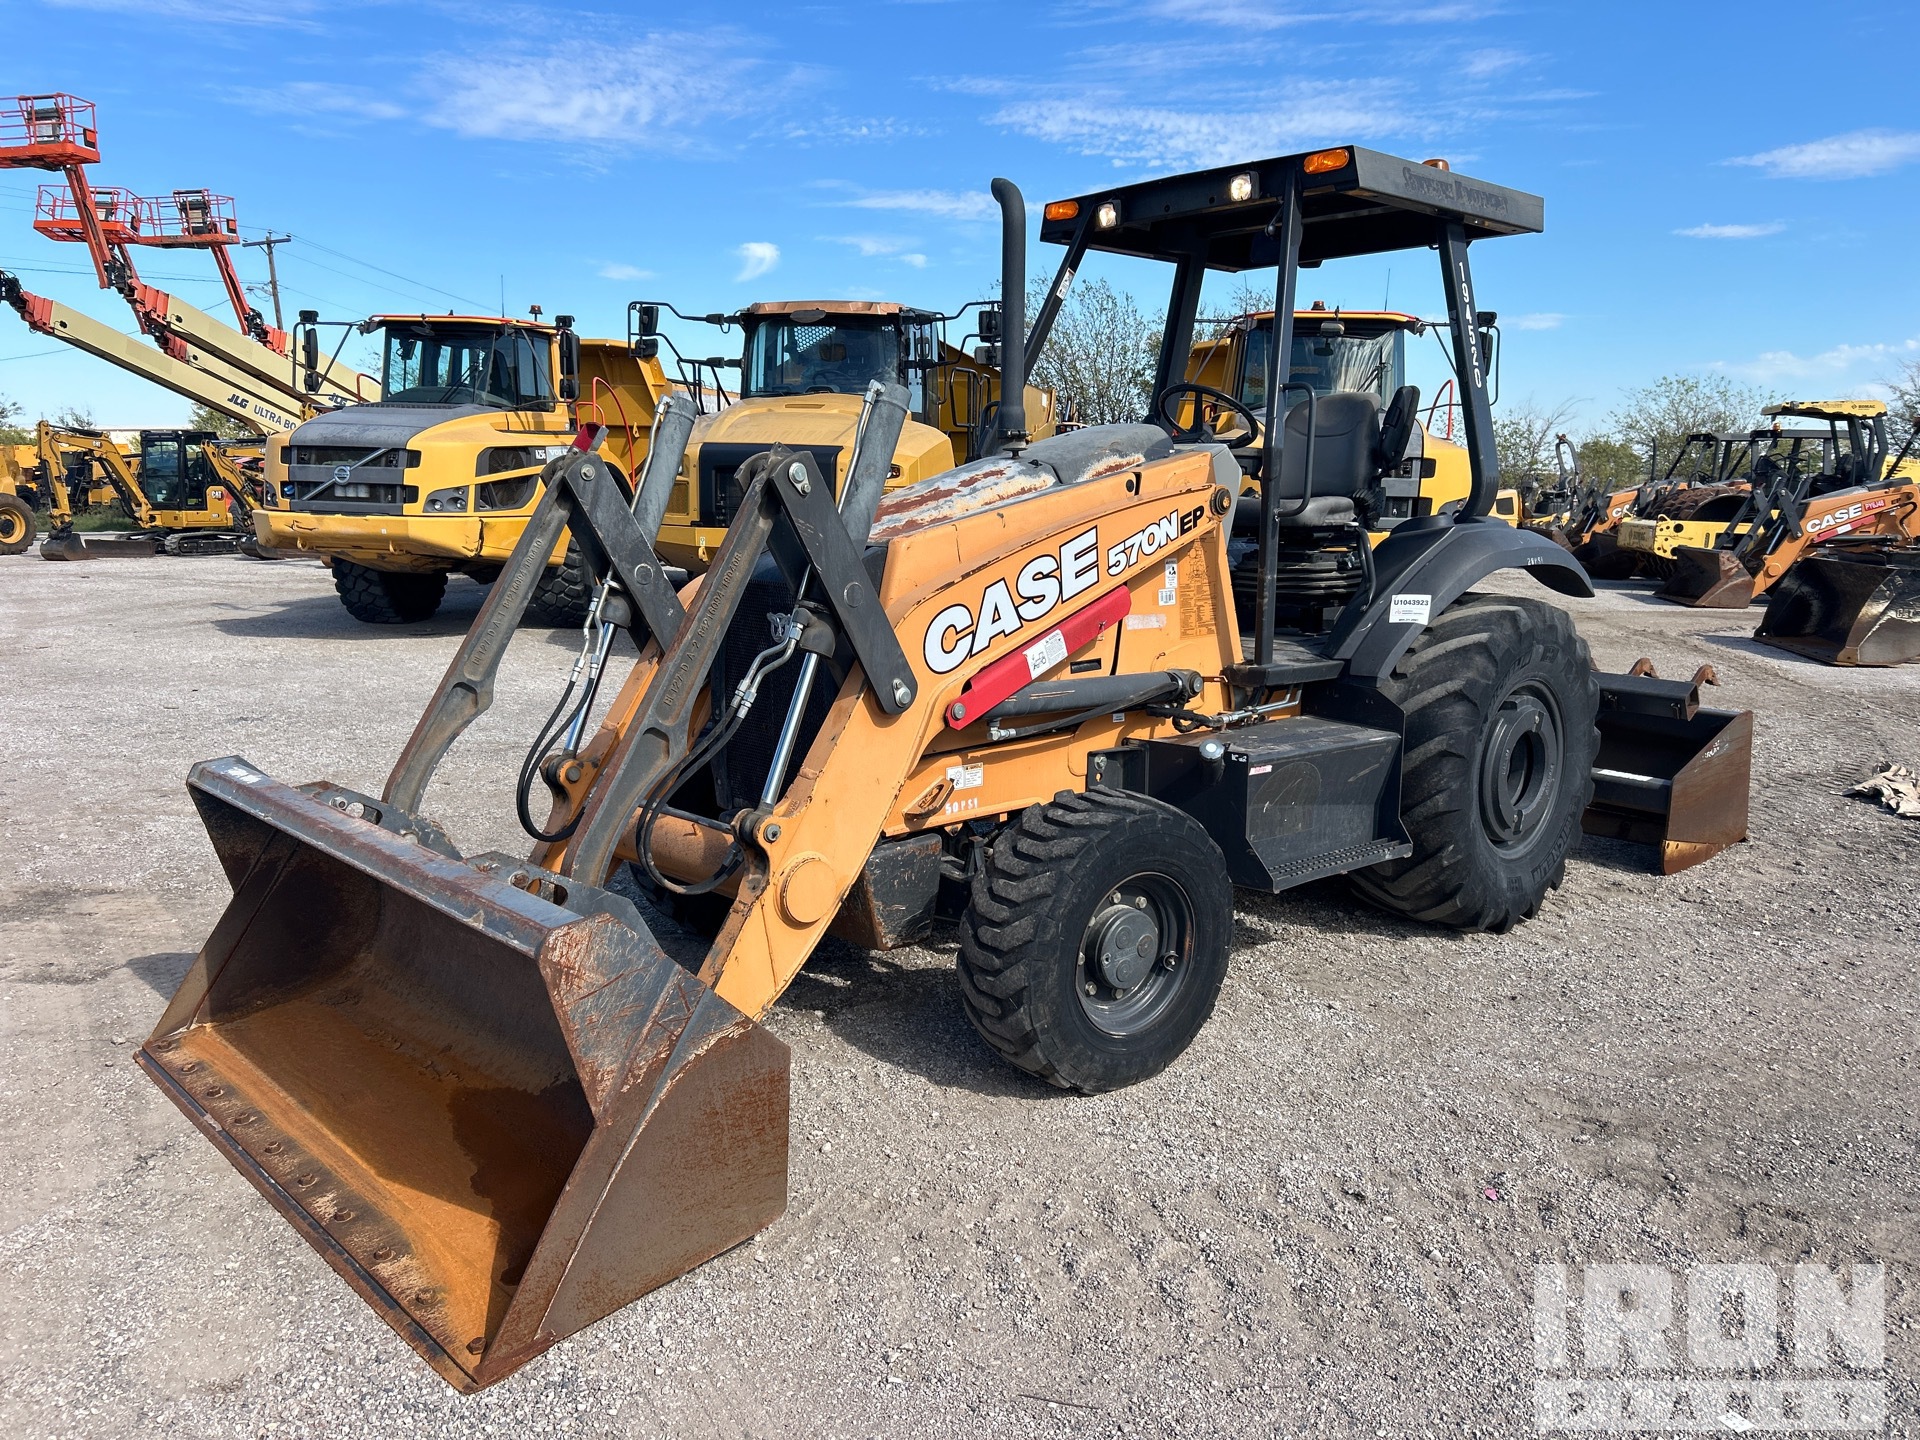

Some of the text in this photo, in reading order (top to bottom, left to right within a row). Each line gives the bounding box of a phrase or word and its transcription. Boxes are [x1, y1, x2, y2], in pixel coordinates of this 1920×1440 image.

[1459, 262, 1482, 388] 194520
[227, 394, 249, 408] JLG
[253, 404, 282, 426] ULTRA
[212, 490, 222, 498] CAT
[1806, 503, 1862, 533] CASE
[924, 526, 1099, 675] CASE
[1107, 510, 1179, 576] 570N
[1180, 505, 1205, 536] EP
[1531, 817, 1575, 884] MICHELIN
